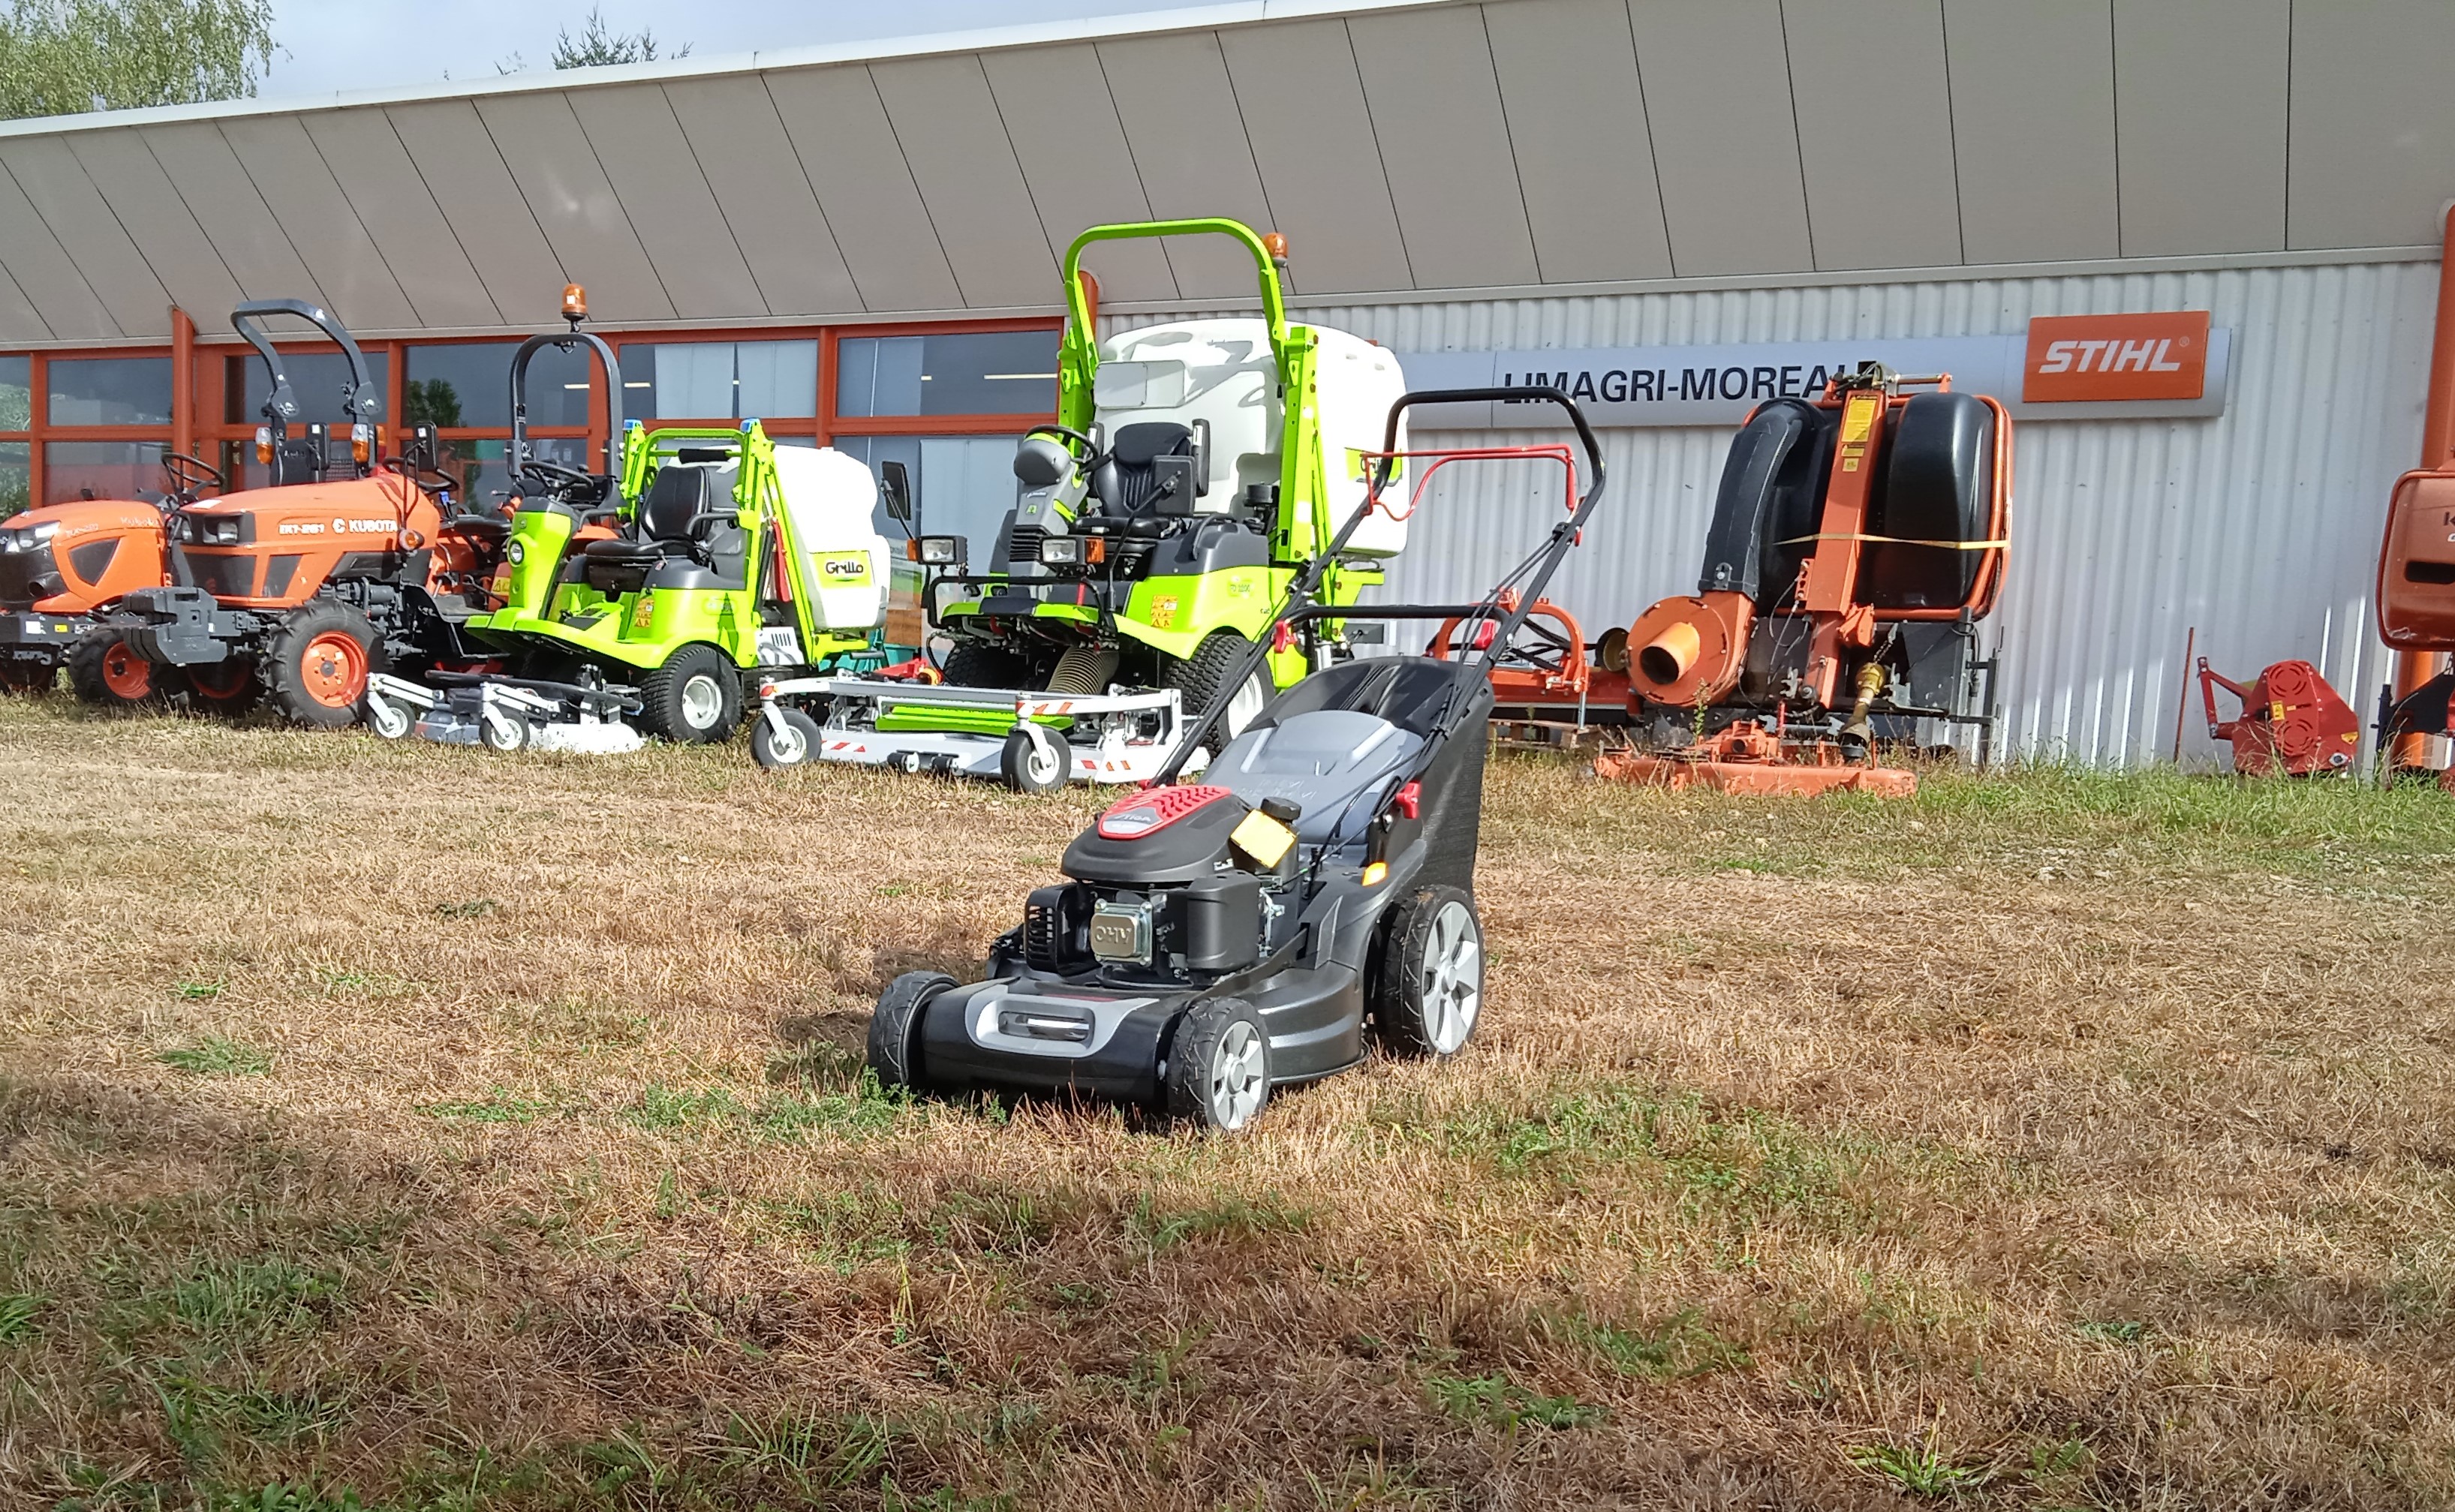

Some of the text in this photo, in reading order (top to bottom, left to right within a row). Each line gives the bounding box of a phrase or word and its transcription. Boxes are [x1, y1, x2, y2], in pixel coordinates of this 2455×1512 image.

[2038, 338, 2181, 374] STIHL
[1503, 364, 1846, 404] LIMAGRI-MOREA
[348, 519, 398, 533] KUBOTA
[825, 561, 864, 574] Grillo
